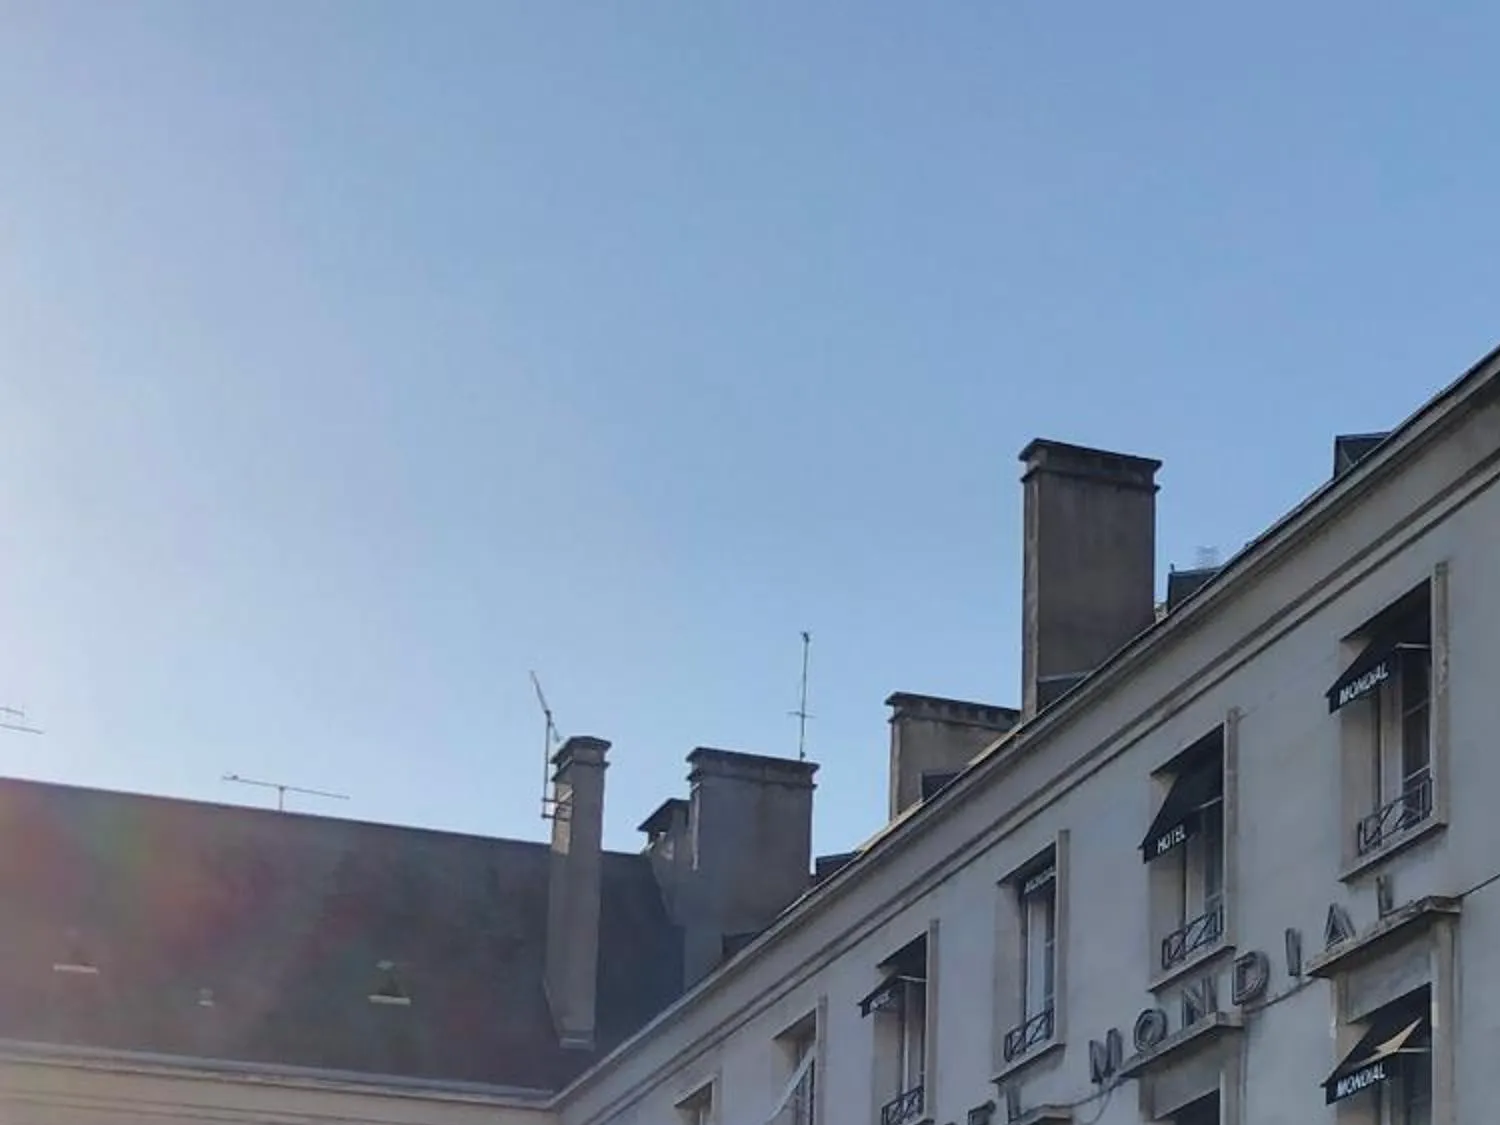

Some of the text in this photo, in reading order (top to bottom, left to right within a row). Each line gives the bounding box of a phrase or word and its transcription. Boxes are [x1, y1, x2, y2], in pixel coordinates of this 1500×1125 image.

[1340, 661, 1389, 705] MONDIAL
[1157, 823, 1186, 855] HOTEL
[1088, 873, 1412, 1085] MONDIAL
[1336, 1062, 1387, 1097] MONDIAL
